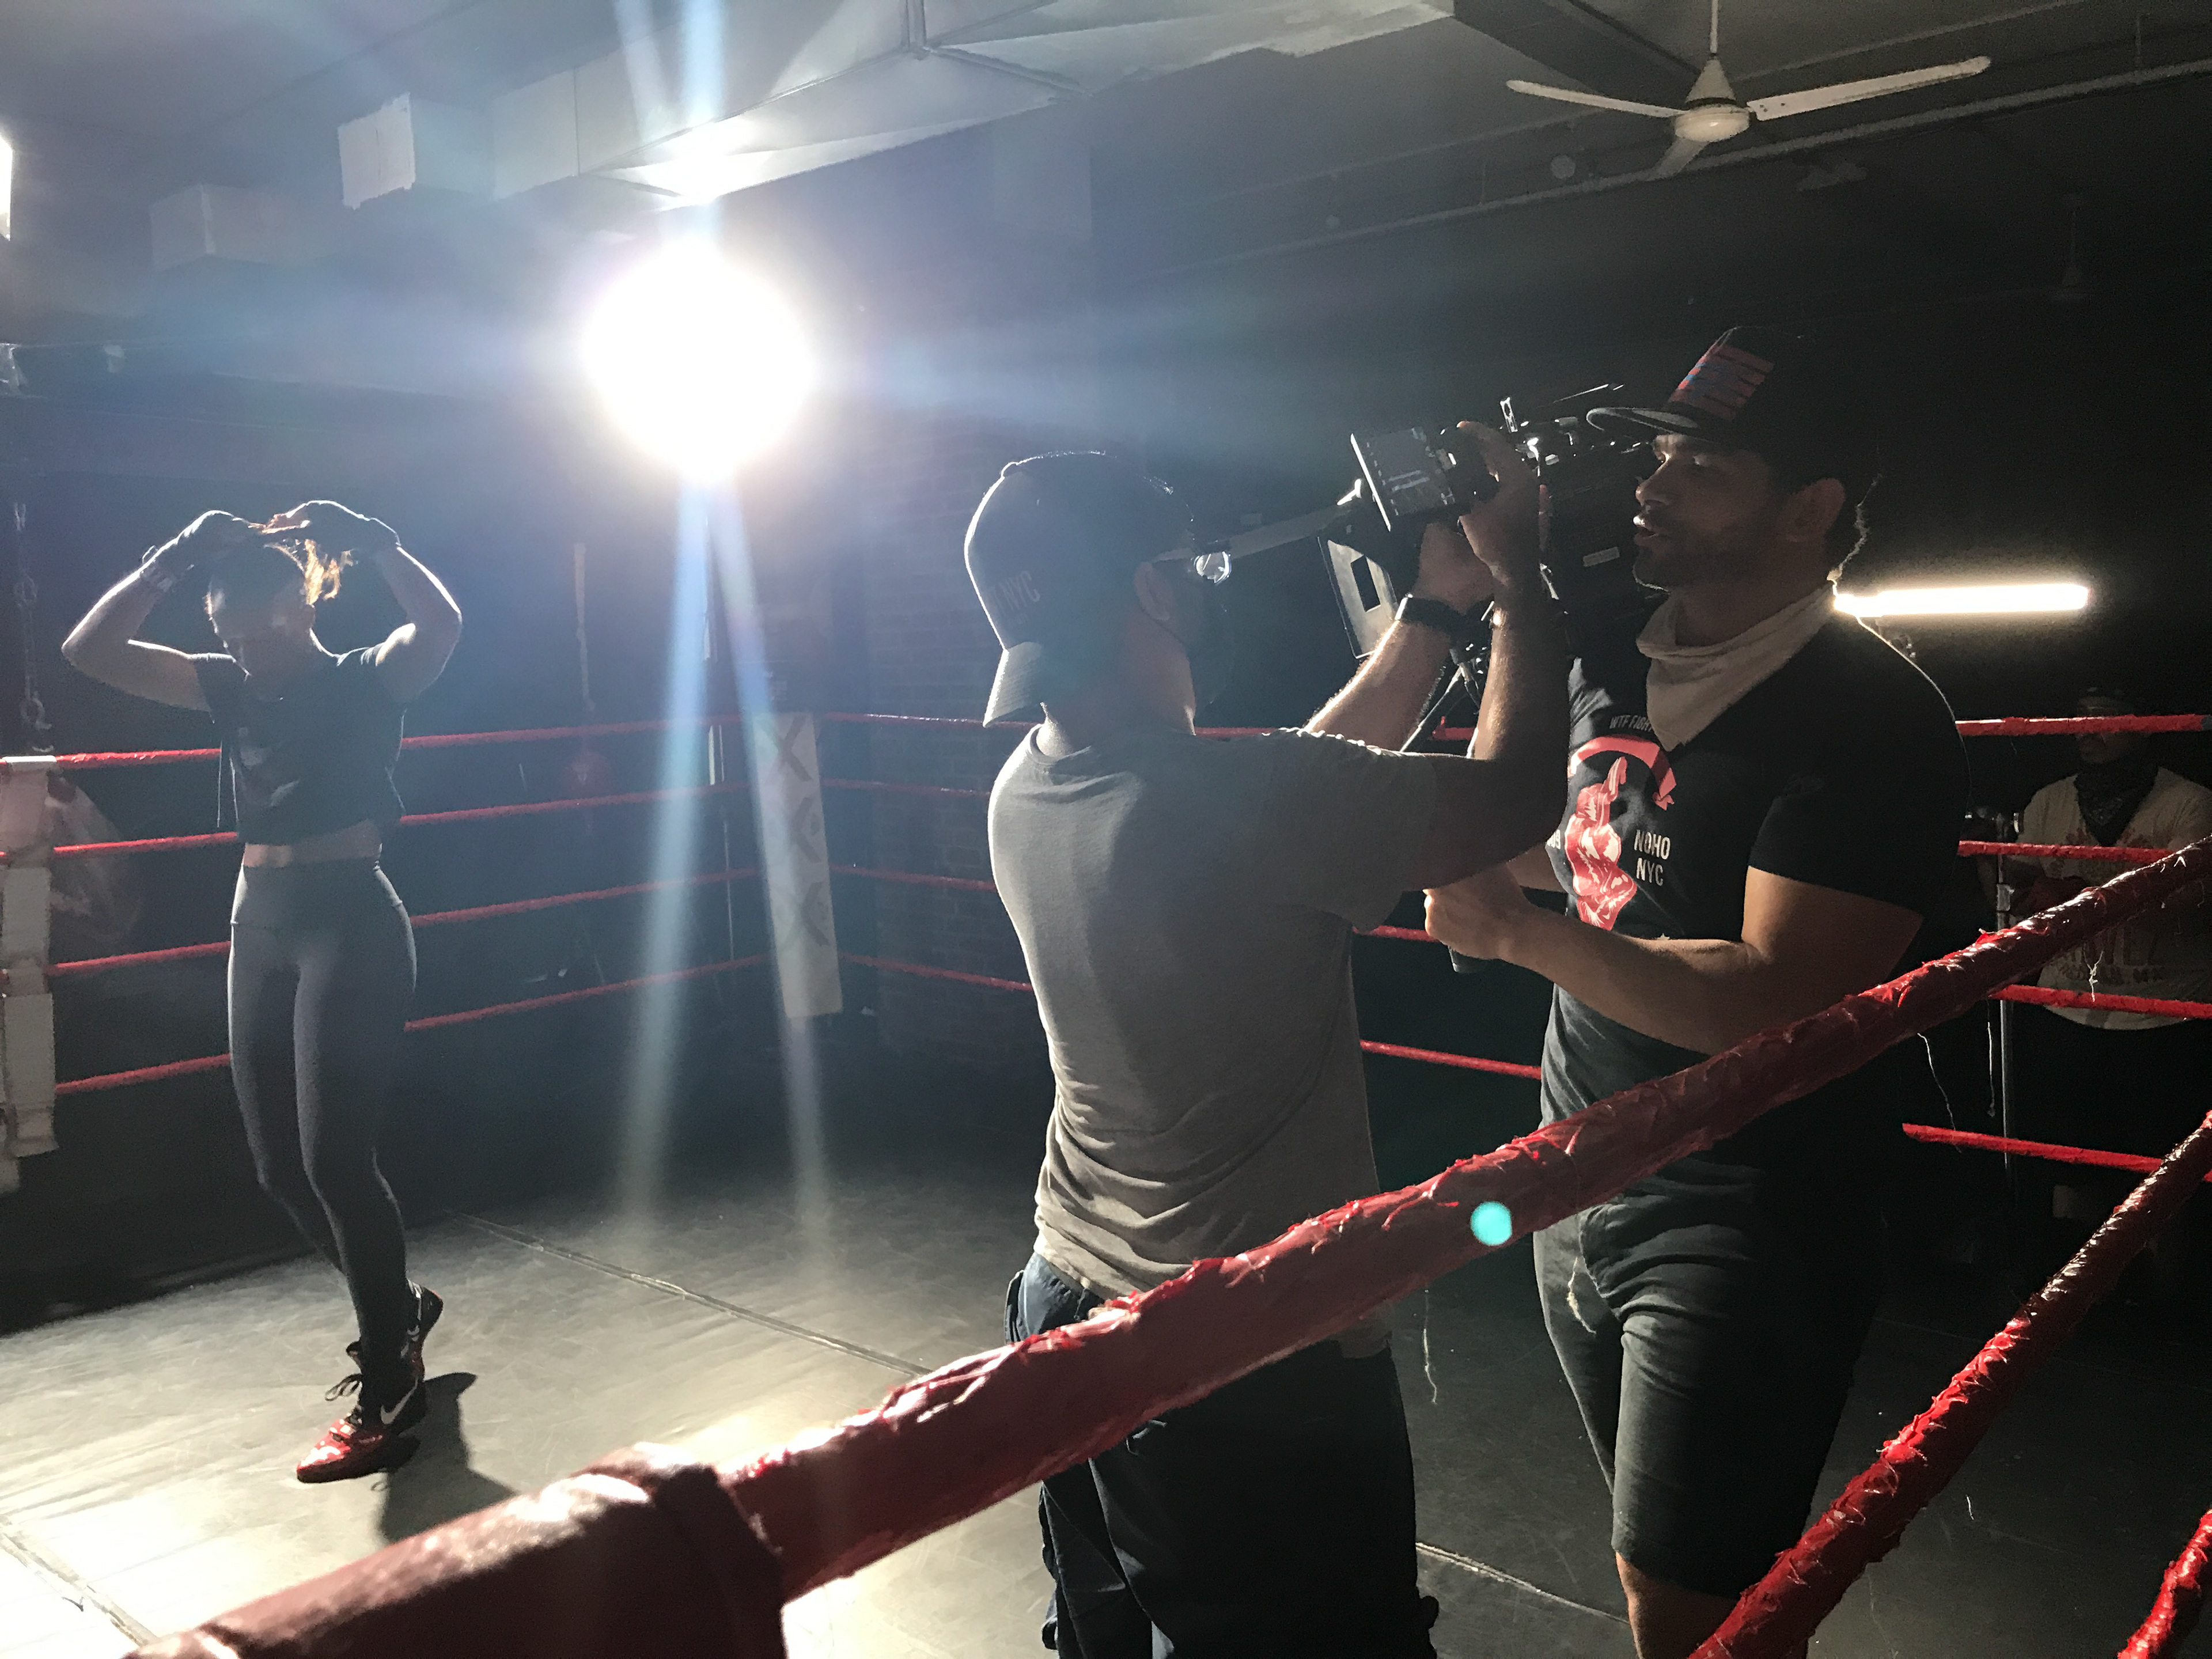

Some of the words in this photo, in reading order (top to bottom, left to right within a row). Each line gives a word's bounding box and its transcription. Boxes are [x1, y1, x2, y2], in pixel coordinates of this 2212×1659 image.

[998, 570, 1041, 611] NYC
[1609, 714, 1631, 729] WTF
[1633, 829, 1671, 860] NOHO
[1635, 857, 1664, 887] NYC
